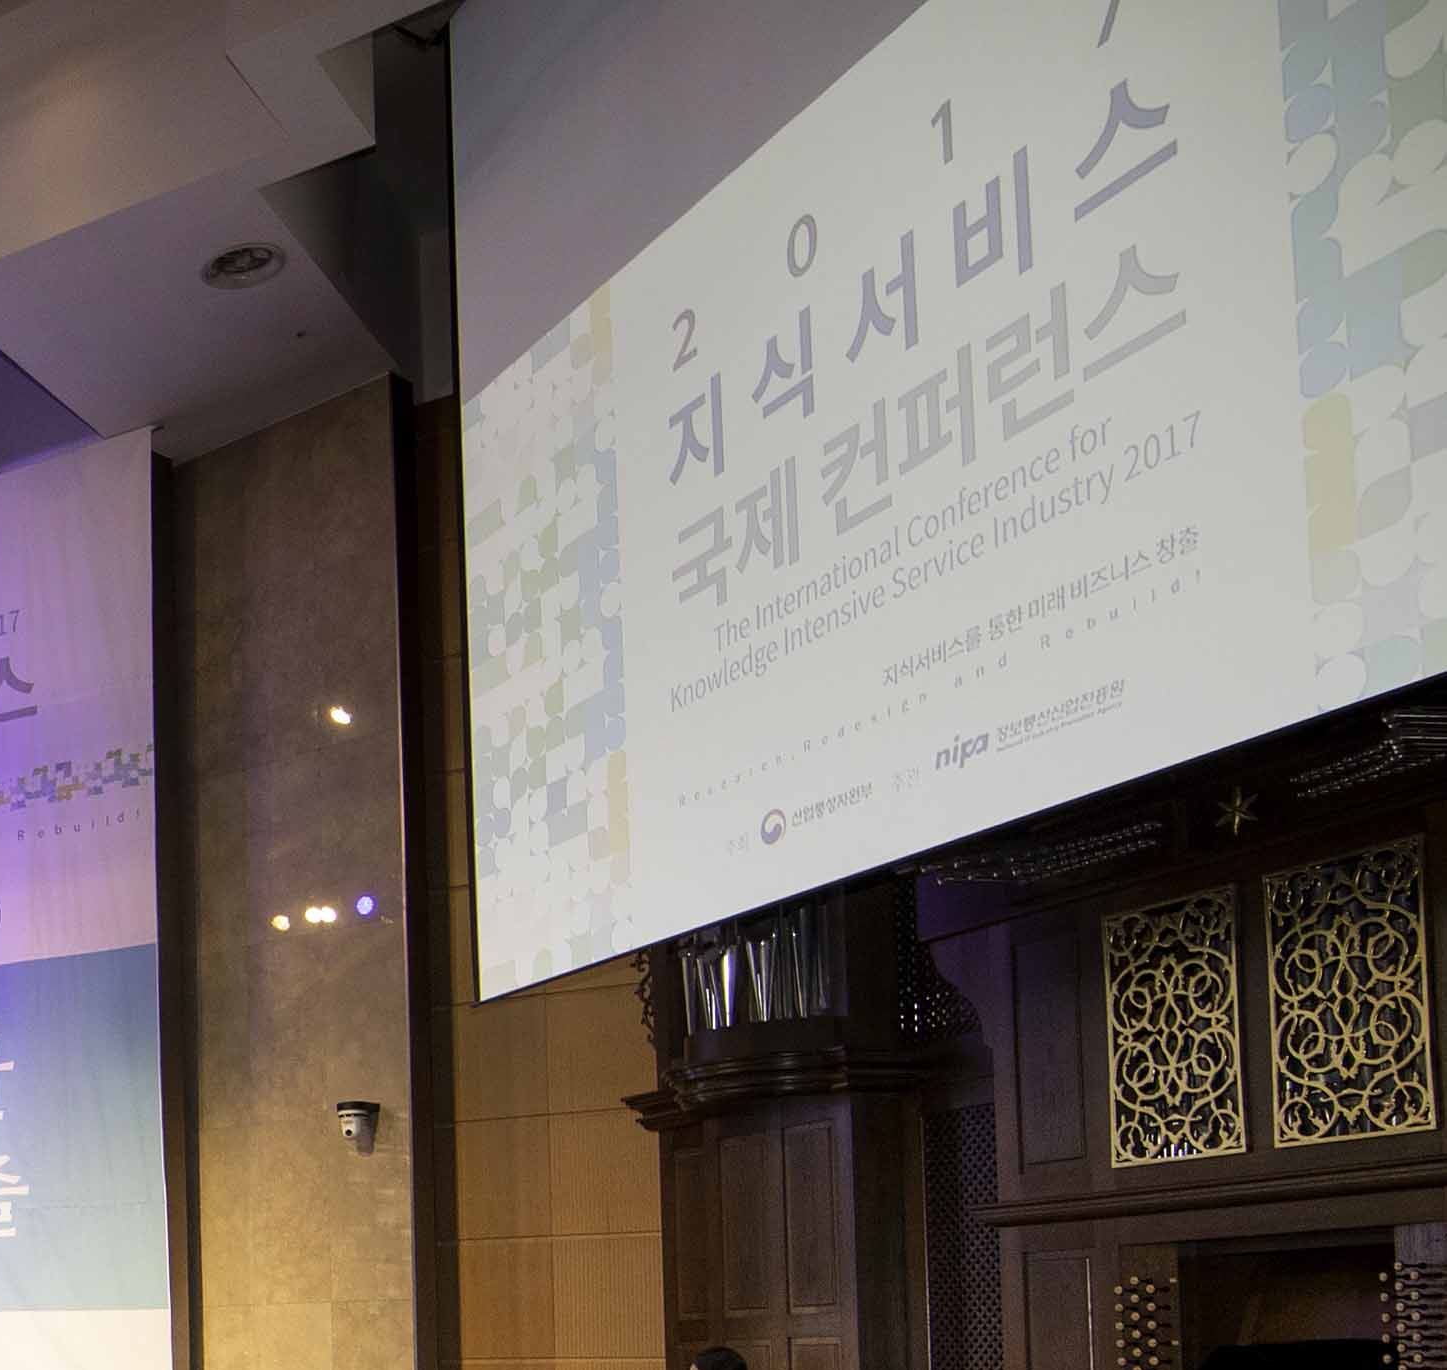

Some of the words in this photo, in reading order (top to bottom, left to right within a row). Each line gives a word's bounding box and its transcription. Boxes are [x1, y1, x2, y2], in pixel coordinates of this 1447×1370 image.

[668, 78, 1178, 486] 지식서비스
[672, 455, 800, 607] 국제
[820, 243, 1187, 536] 컨퍼런스
[714, 616, 751, 653] The
[756, 526, 899, 632] International
[907, 447, 1060, 548] Conference
[1068, 415, 1112, 461] for
[670, 640, 779, 712] Knowledge
[784, 584, 885, 655] Intensive
[892, 532, 985, 599] Service
[994, 463, 1115, 548] Industry
[1123, 410, 1202, 482] 2017
[1028, 584, 1066, 619] 미래
[1069, 551, 1153, 600] 비즈니스
[935, 732, 990, 770] nipa
